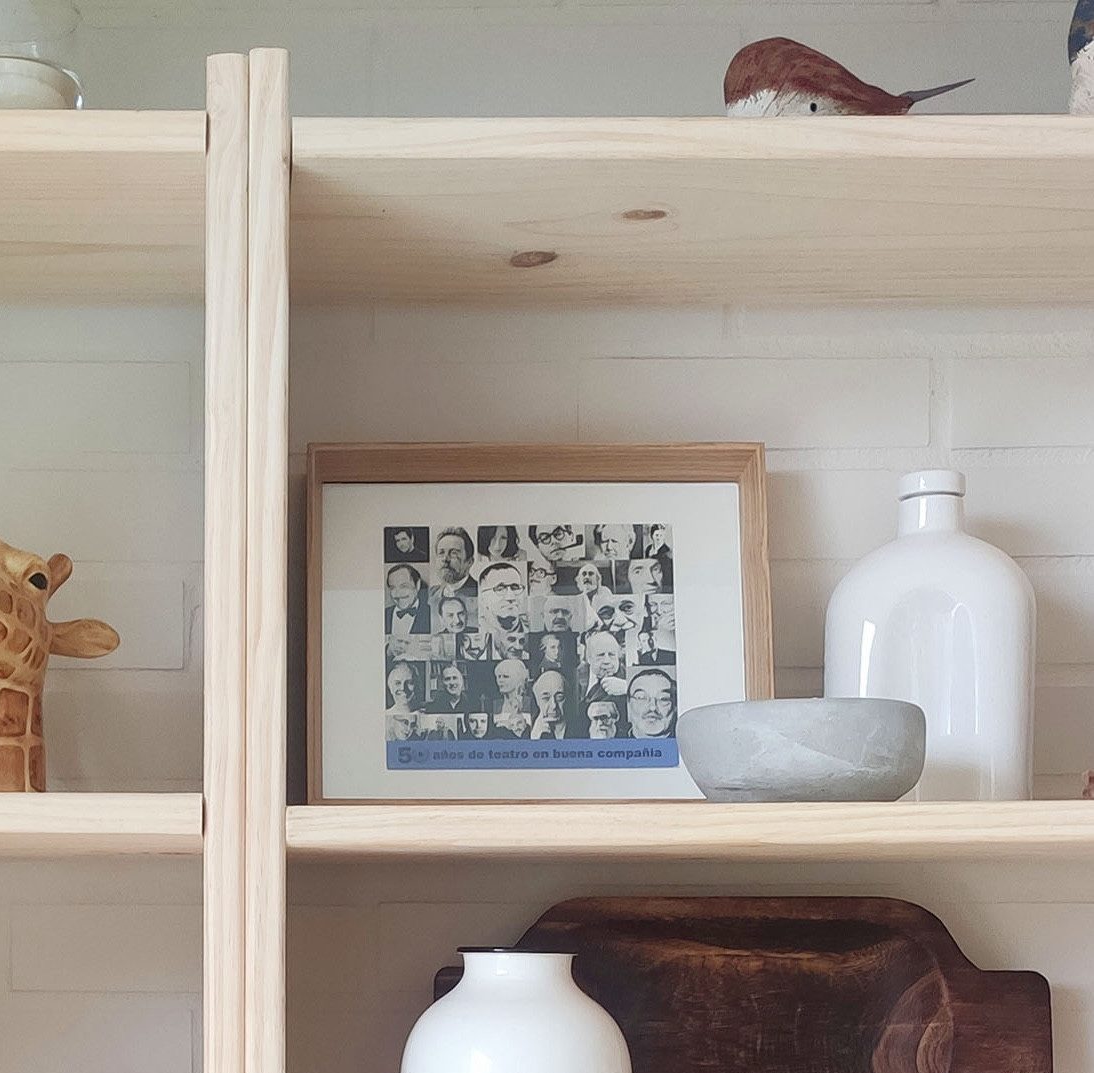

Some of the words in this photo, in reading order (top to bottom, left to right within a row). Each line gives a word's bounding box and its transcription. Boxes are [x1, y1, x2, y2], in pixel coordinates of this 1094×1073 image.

[432, 748, 464, 760] años
[468, 749, 484, 759] de
[488, 749, 530, 759] teatro
[532, 750, 549, 759] en
[552, 749, 594, 760] buena
[596, 748, 662, 762] compañía
